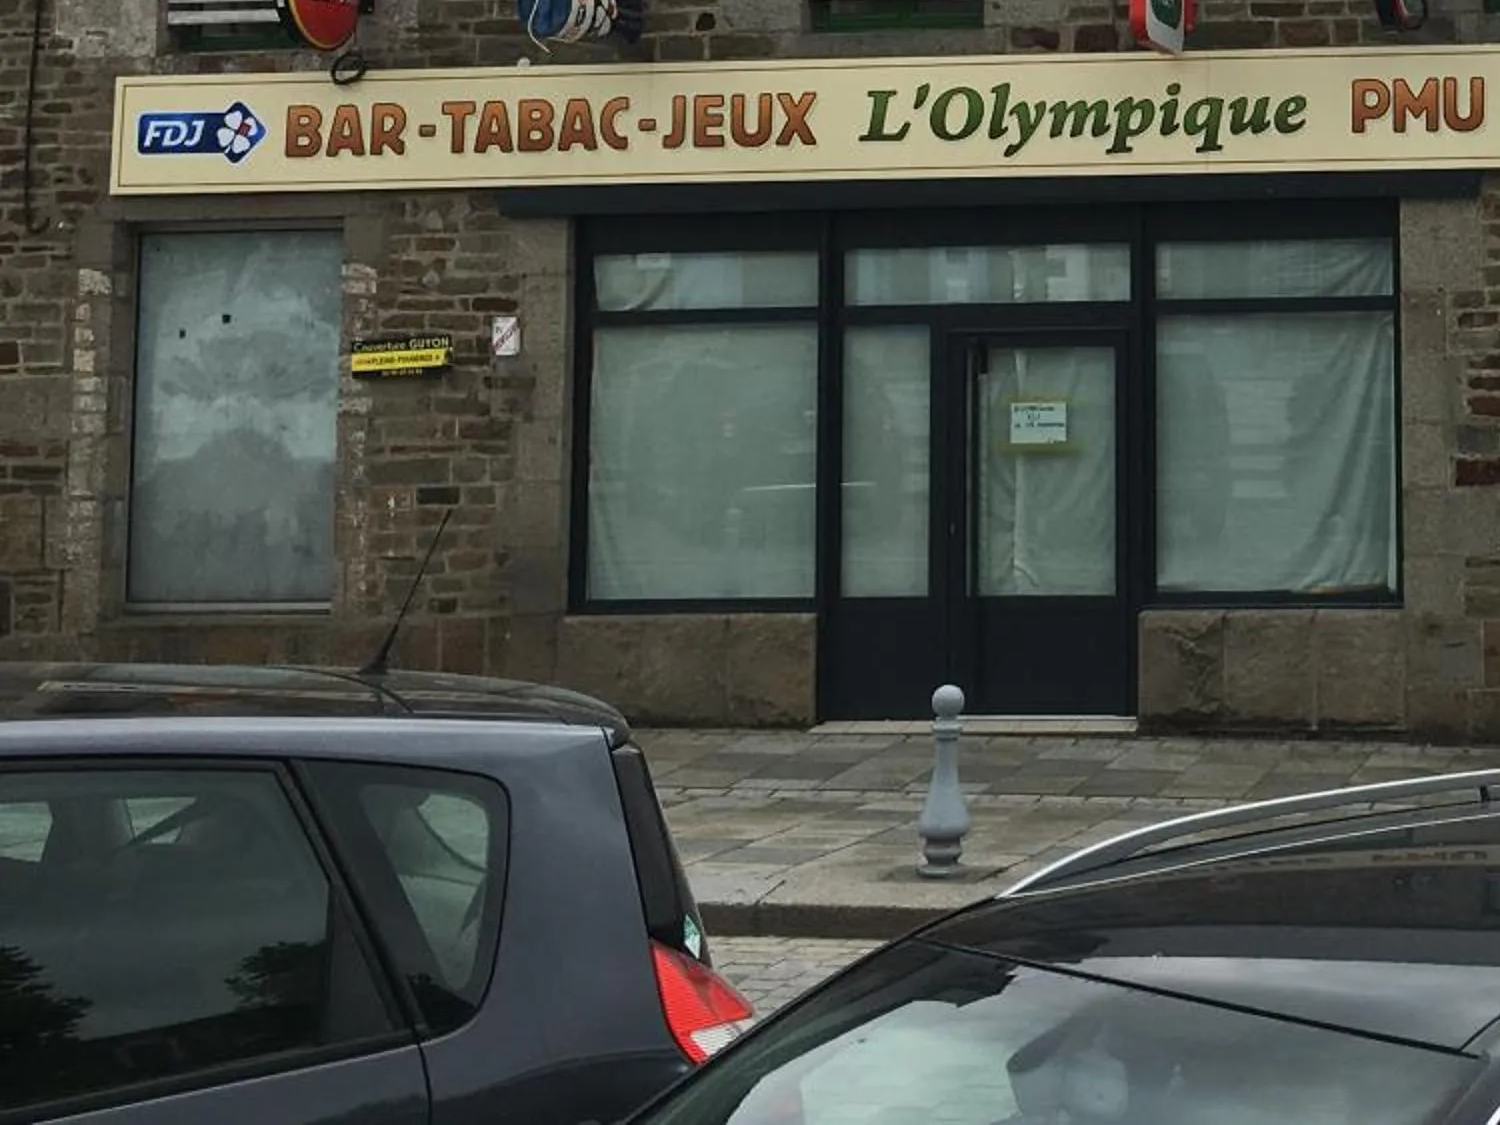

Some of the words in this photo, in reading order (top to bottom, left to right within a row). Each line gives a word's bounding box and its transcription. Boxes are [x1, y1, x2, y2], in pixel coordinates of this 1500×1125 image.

[143, 120, 205, 147] FDJ
[859, 82, 1307, 156] L'Olympique
[1352, 78, 1485, 134] PMU
